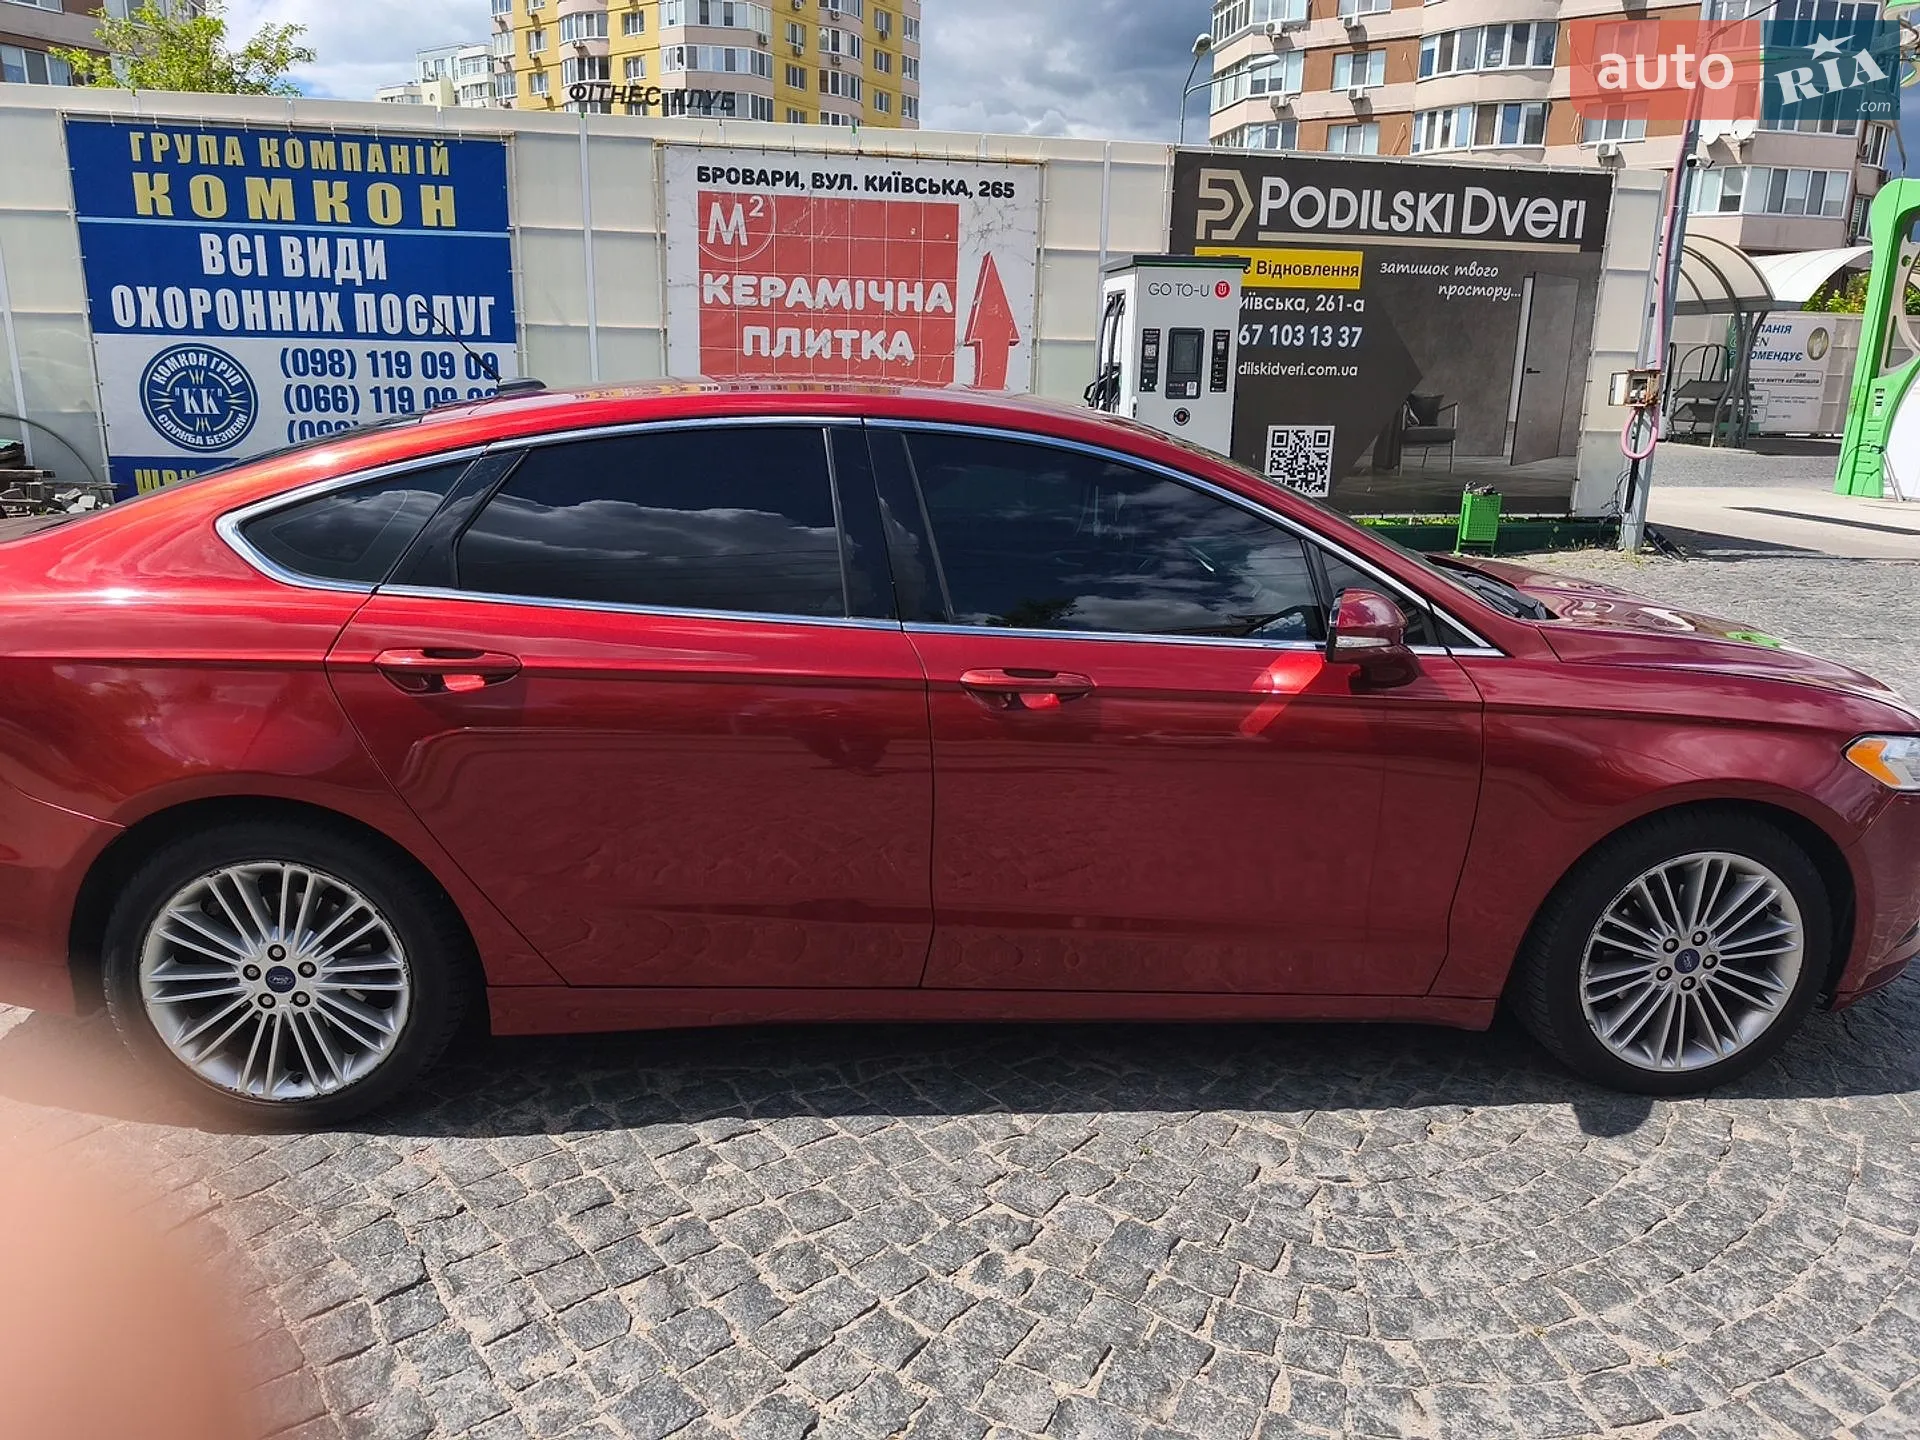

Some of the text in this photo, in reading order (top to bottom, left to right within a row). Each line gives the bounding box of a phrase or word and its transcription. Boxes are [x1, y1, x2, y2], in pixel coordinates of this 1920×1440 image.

[569, 83, 736, 111] ФІТНЕС КЛУБ
[129, 131, 450, 176] ГРУПА КОМПАНІЙ
[697, 165, 1015, 199] БРОВАРИ, ВУЛ. КИЇВСЬКА, 265
[132, 172, 457, 228] КОМКОН
[200, 233, 388, 287] ВСІ ВИДИ
[1256, 260, 1360, 280] Відновлення
[1379, 261, 1499, 278] затишок твого
[702, 273, 954, 313] КЕРАМІЧНА
[1148, 282, 1172, 297] GO
[1174, 283, 1210, 298] TO-U
[1240, 291, 1365, 316] иївська, 261-а
[1437, 284, 1522, 302] простору...
[110, 285, 496, 337] ОХОРОННИХ ПОСЛУГ
[742, 325, 915, 361] ПЛИТКА
[1239, 324, 1263, 346] 67
[1269, 324, 1305, 347] 103
[1310, 325, 1333, 347] 13
[1338, 326, 1363, 348] 37
[1758, 323, 1792, 335] ПАНІЯ
[152, 351, 244, 387] КОМКОН ГРУП
[280, 347, 499, 380] (098) 119 09 09
[1238, 361, 1358, 377] dilskidveri.com.ua
[284, 384, 360, 415] (066)
[369, 386, 416, 415] 119
[157, 413, 248, 446] СЛУЖБА БЕЗПЕКИ
